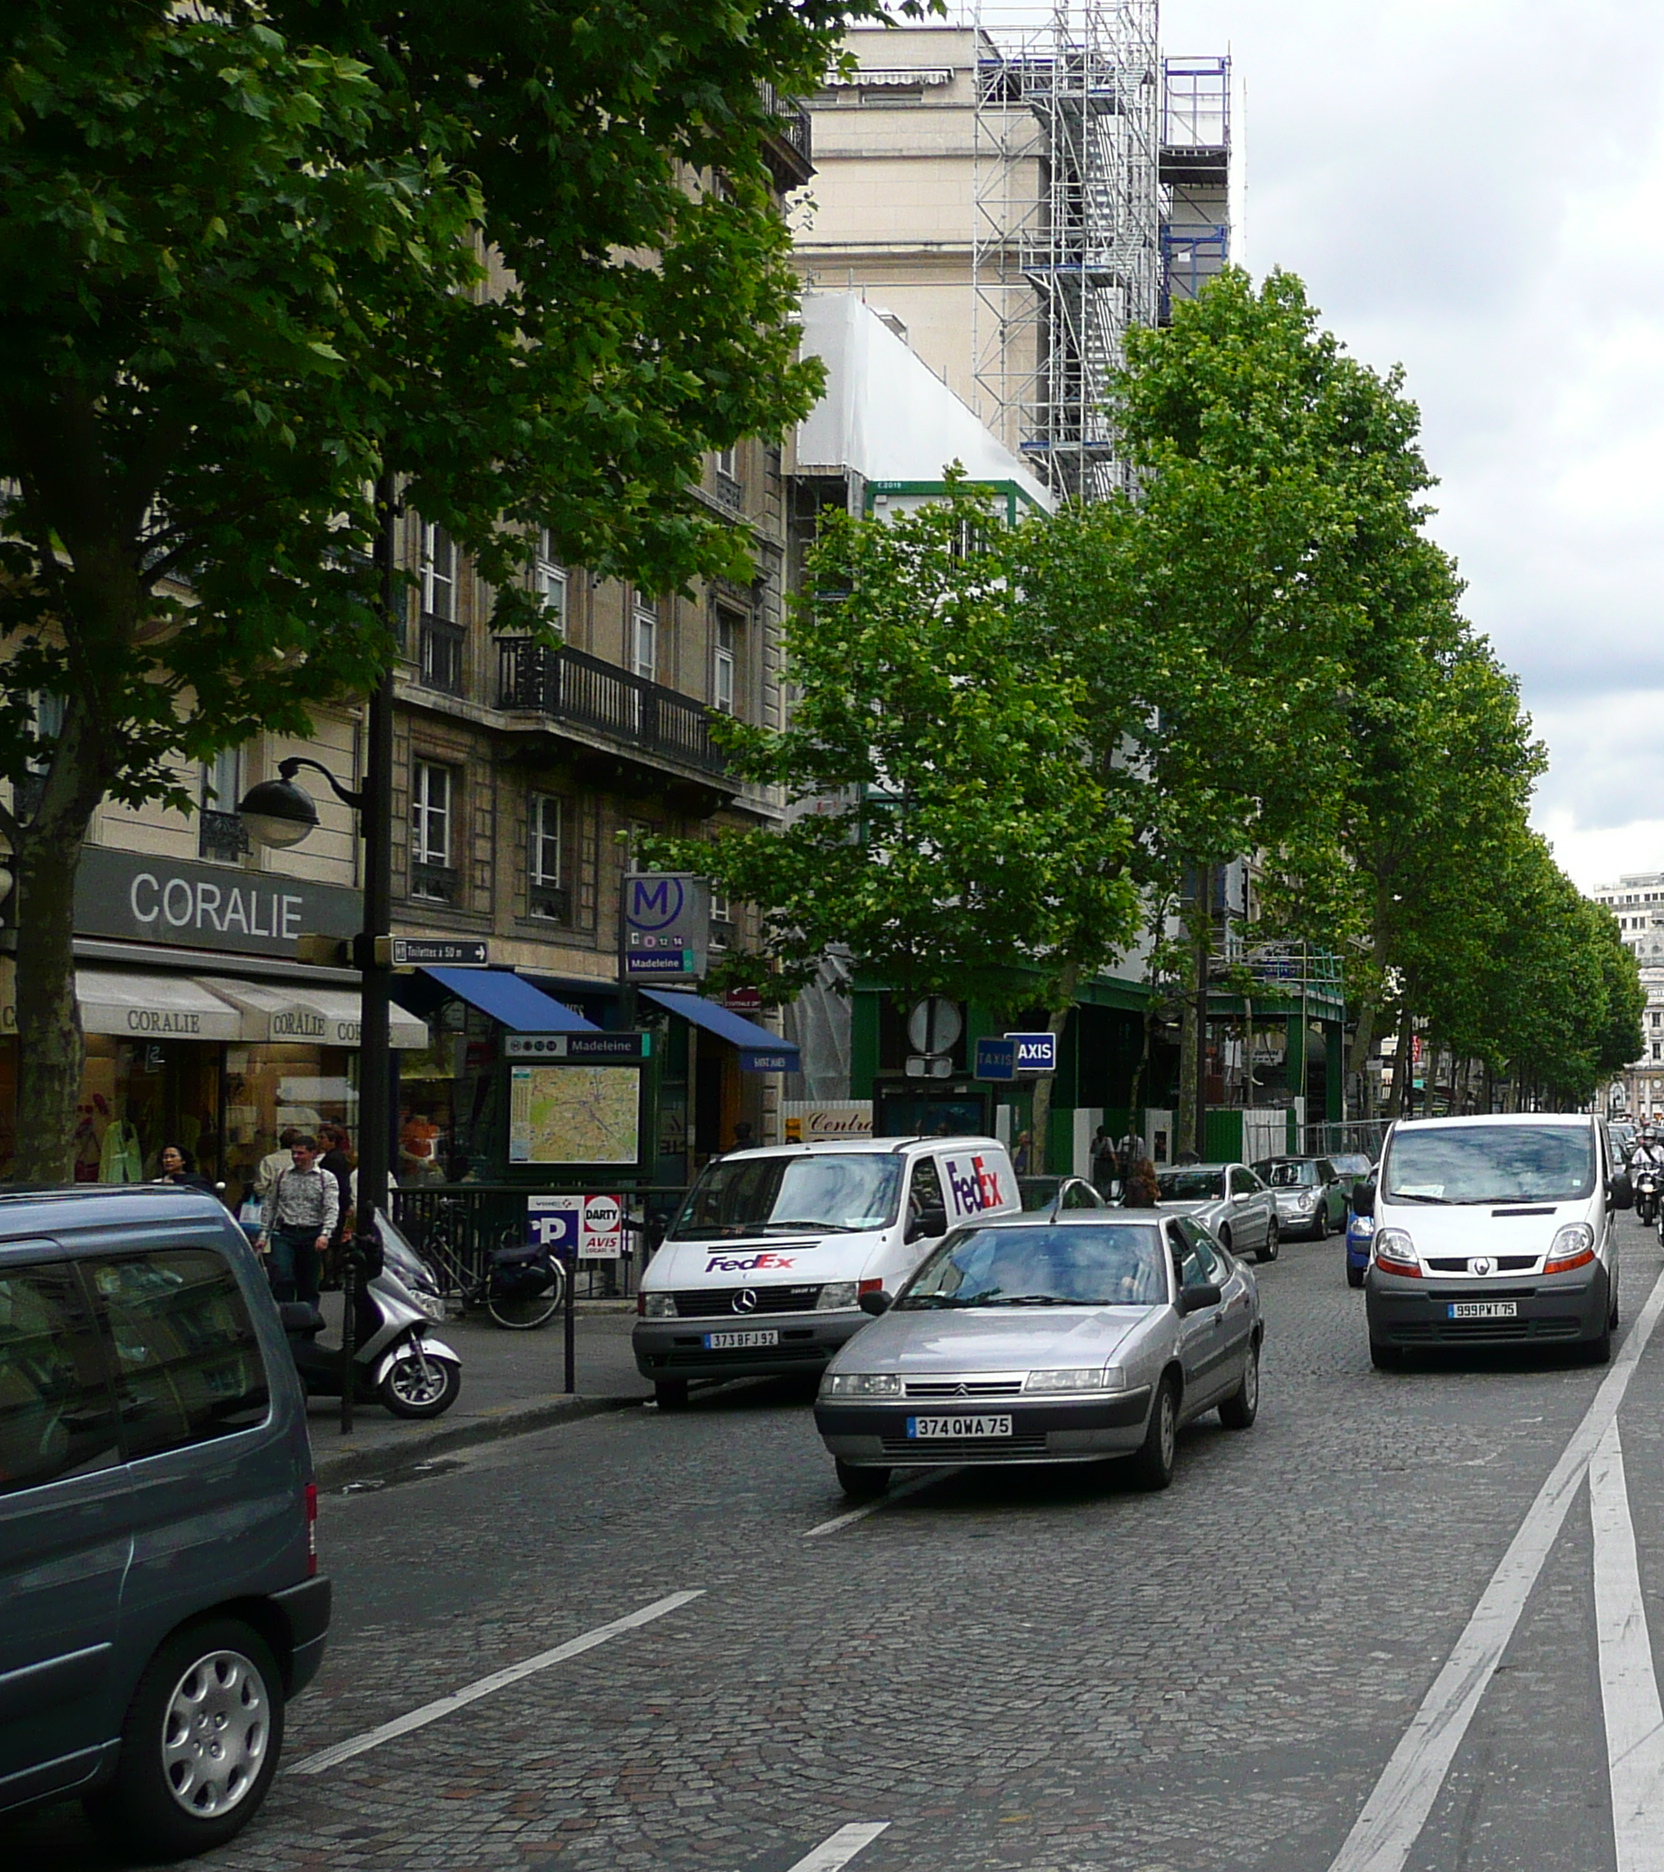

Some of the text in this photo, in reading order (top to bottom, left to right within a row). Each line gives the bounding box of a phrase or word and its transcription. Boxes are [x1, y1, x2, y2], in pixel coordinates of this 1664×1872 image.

[131, 873, 303, 939] CORALIE
[634, 881, 668, 916] M
[407, 945, 436, 957] Toilettes
[631, 958, 679, 968] Madeleine
[128, 1010, 200, 1034] CORALIE
[274, 1014, 325, 1037] CORALIE
[572, 1040, 631, 1051] Madeleine
[1017, 1044, 1052, 1059] AXIS
[978, 1053, 1014, 1066] TAXIS
[945, 1156, 1003, 1216] FedEx
[586, 1210, 617, 1220] DARTY
[541, 1217, 566, 1244] P
[586, 1238, 617, 1247] AVIS
[705, 1254, 797, 1272] FedEx
